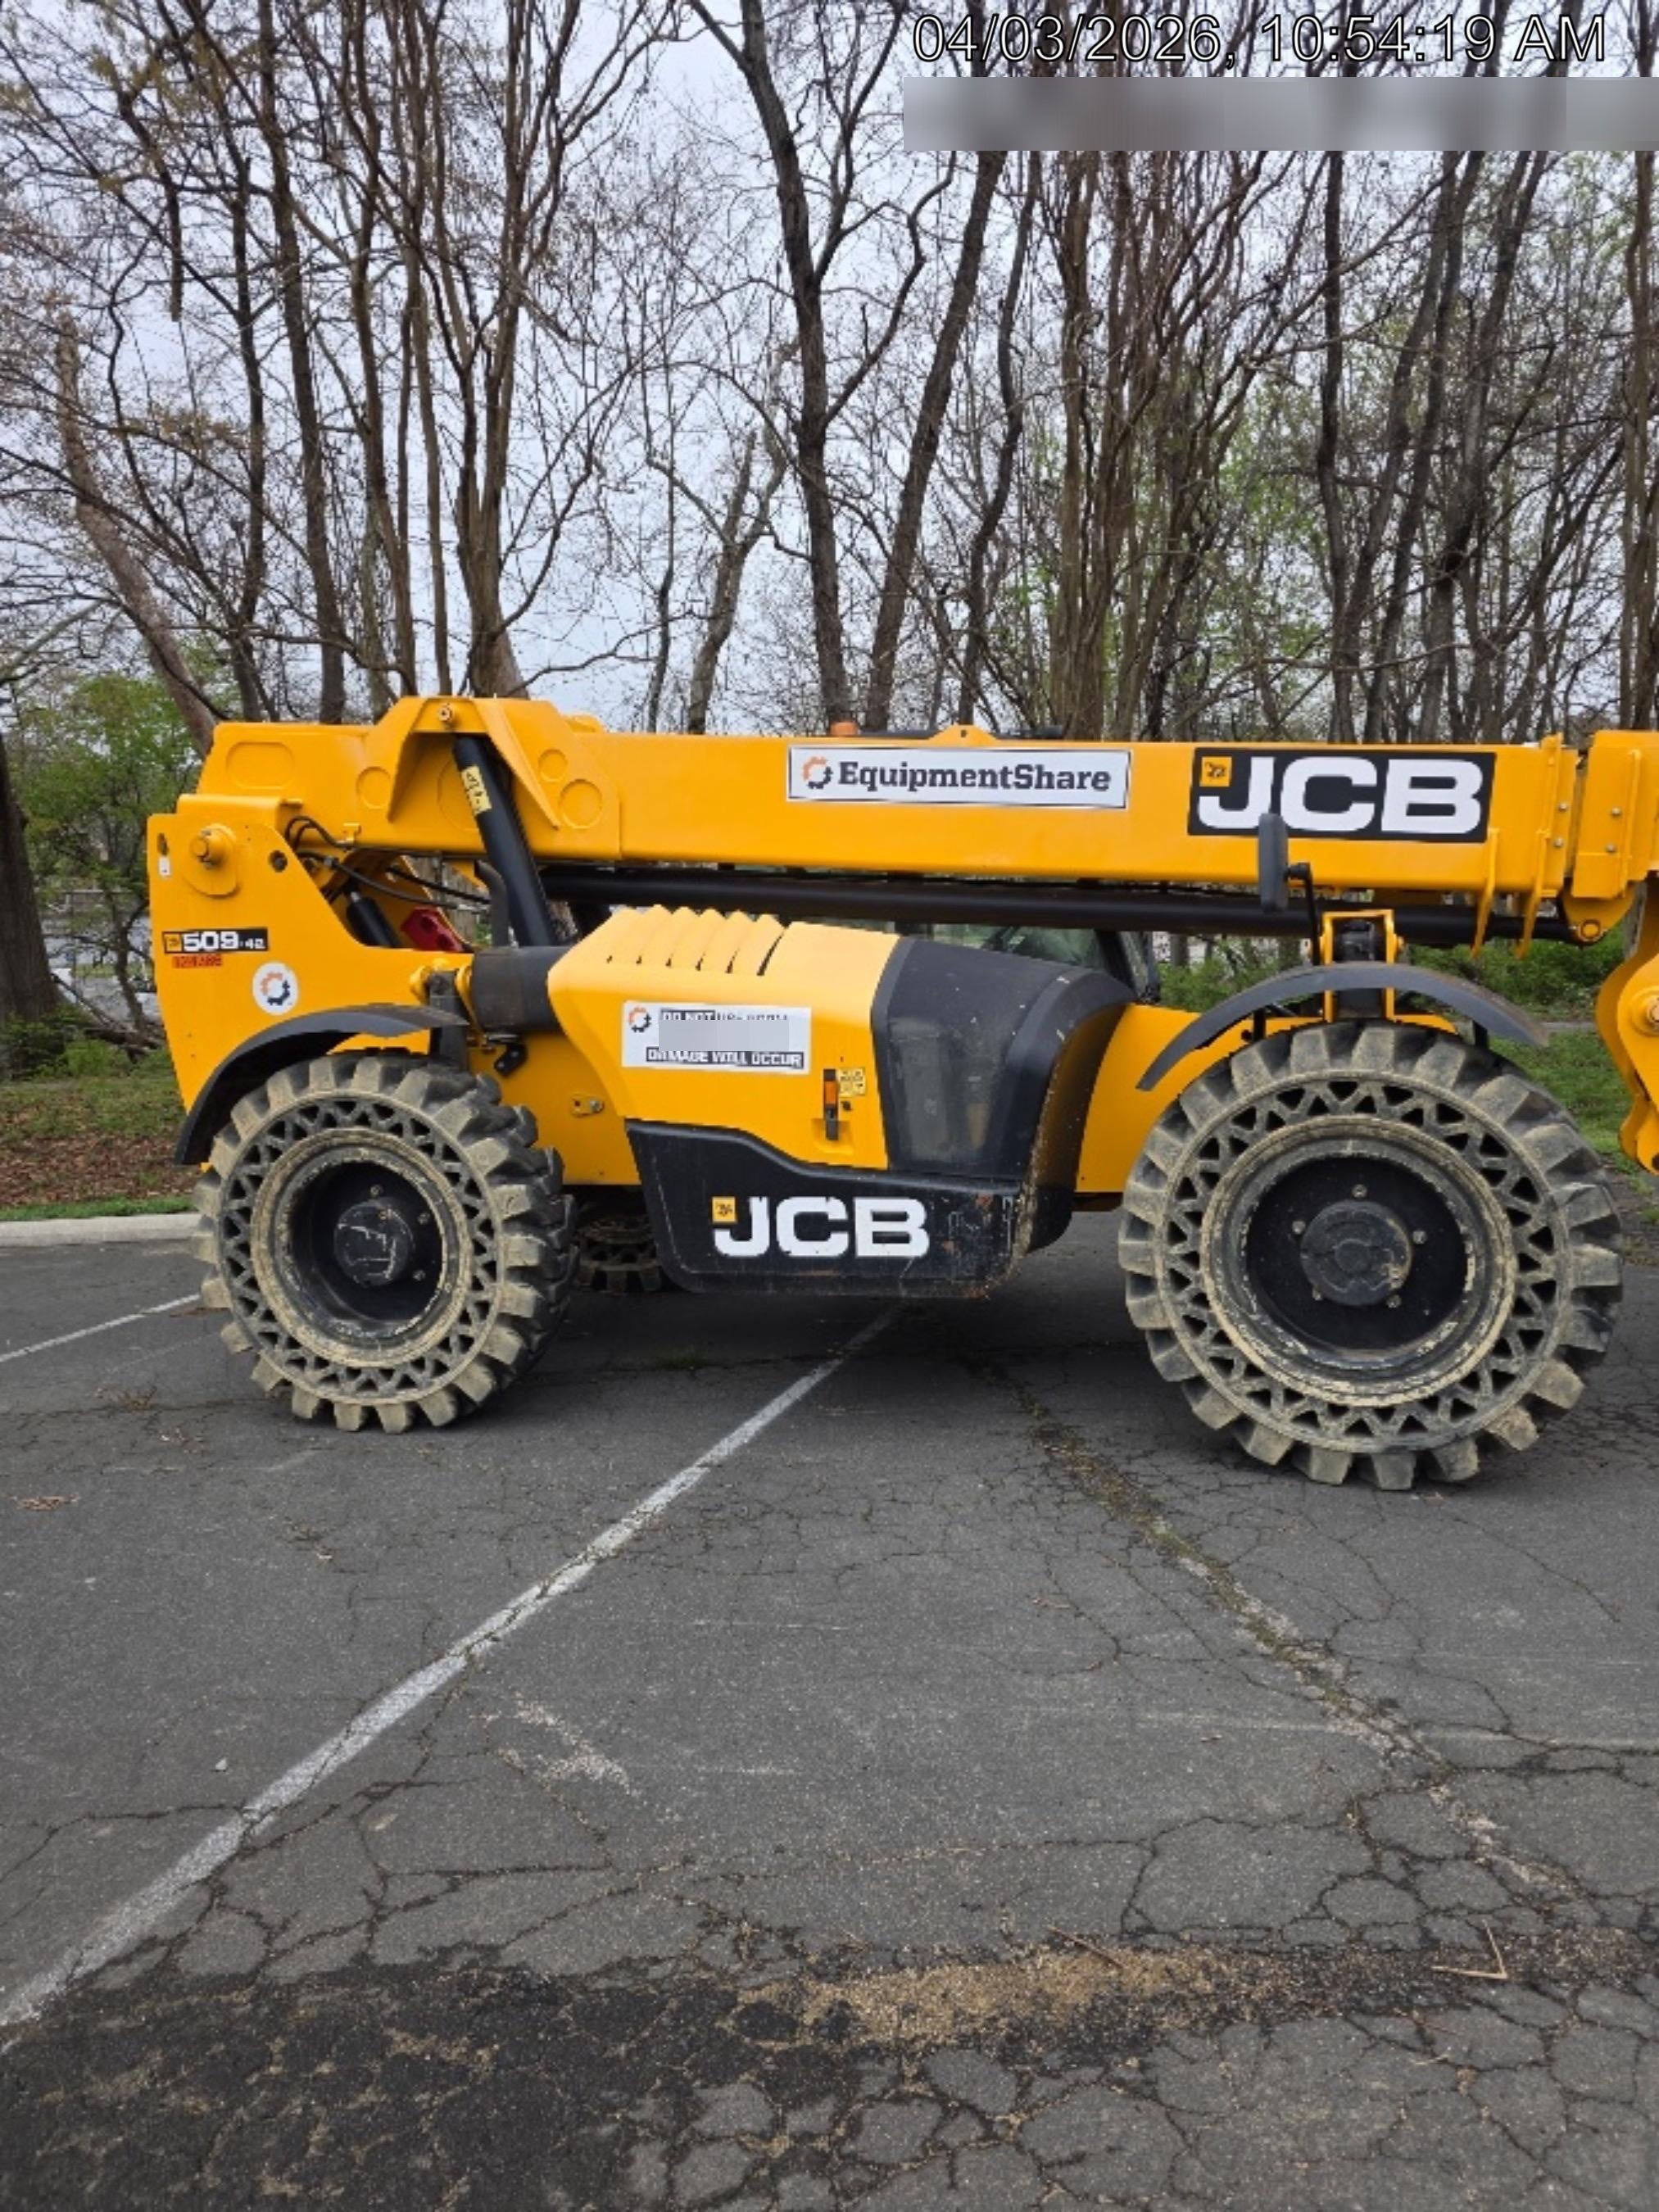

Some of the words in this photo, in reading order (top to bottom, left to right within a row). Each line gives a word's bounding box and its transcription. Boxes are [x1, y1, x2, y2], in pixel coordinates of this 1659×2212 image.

[838, 761, 1111, 791] EquipmentShare
[1198, 755, 1484, 834] JCB
[750, 1052, 802, 1067] OCCUR
[714, 1195, 930, 1258] JCB
